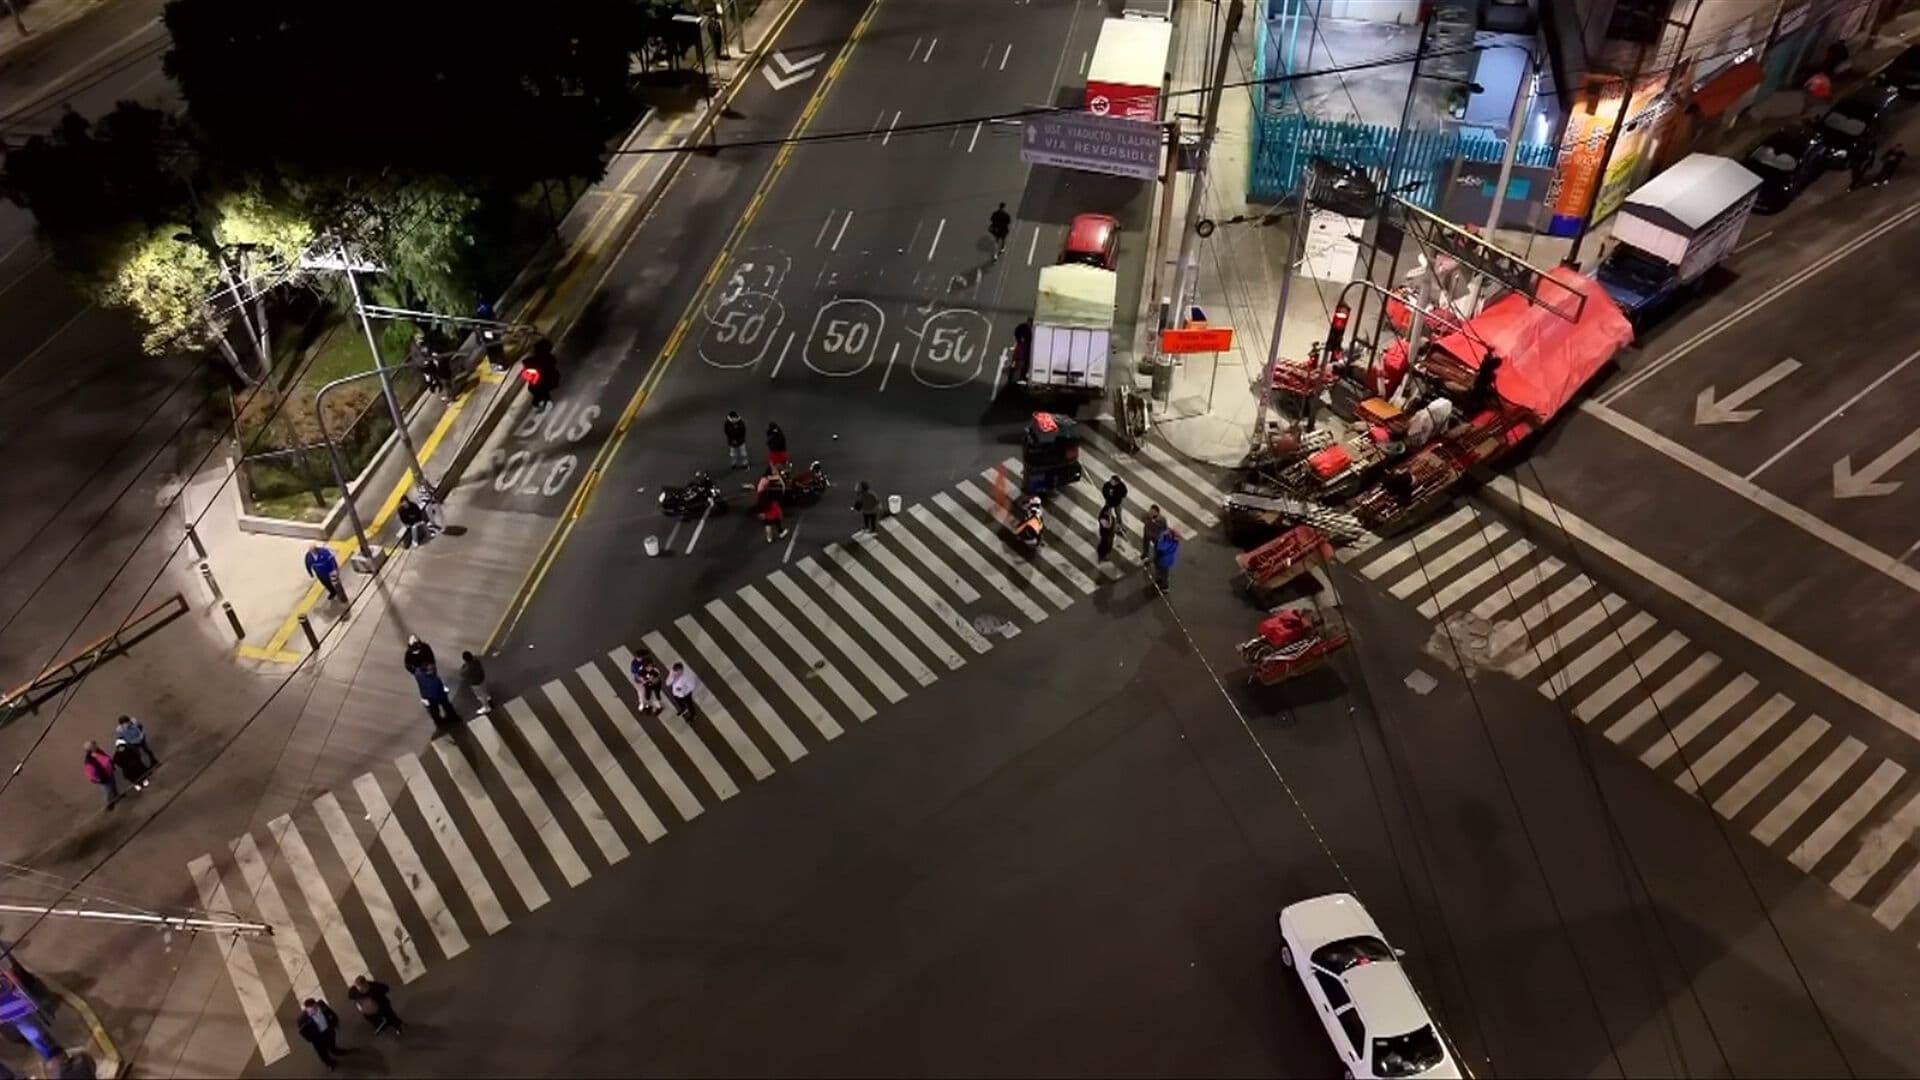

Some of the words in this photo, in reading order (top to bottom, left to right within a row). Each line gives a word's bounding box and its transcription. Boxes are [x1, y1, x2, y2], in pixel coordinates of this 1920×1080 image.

[1045, 139, 1067, 150] VIA
[1074, 143, 1155, 163] REVERSIBLE
[1068, 128, 1111, 142] VIADUCTO
[1116, 134, 1157, 147] TLALPAN
[717, 312, 765, 344] 50
[822, 320, 870, 354] 50
[514, 400, 600, 442] BUS
